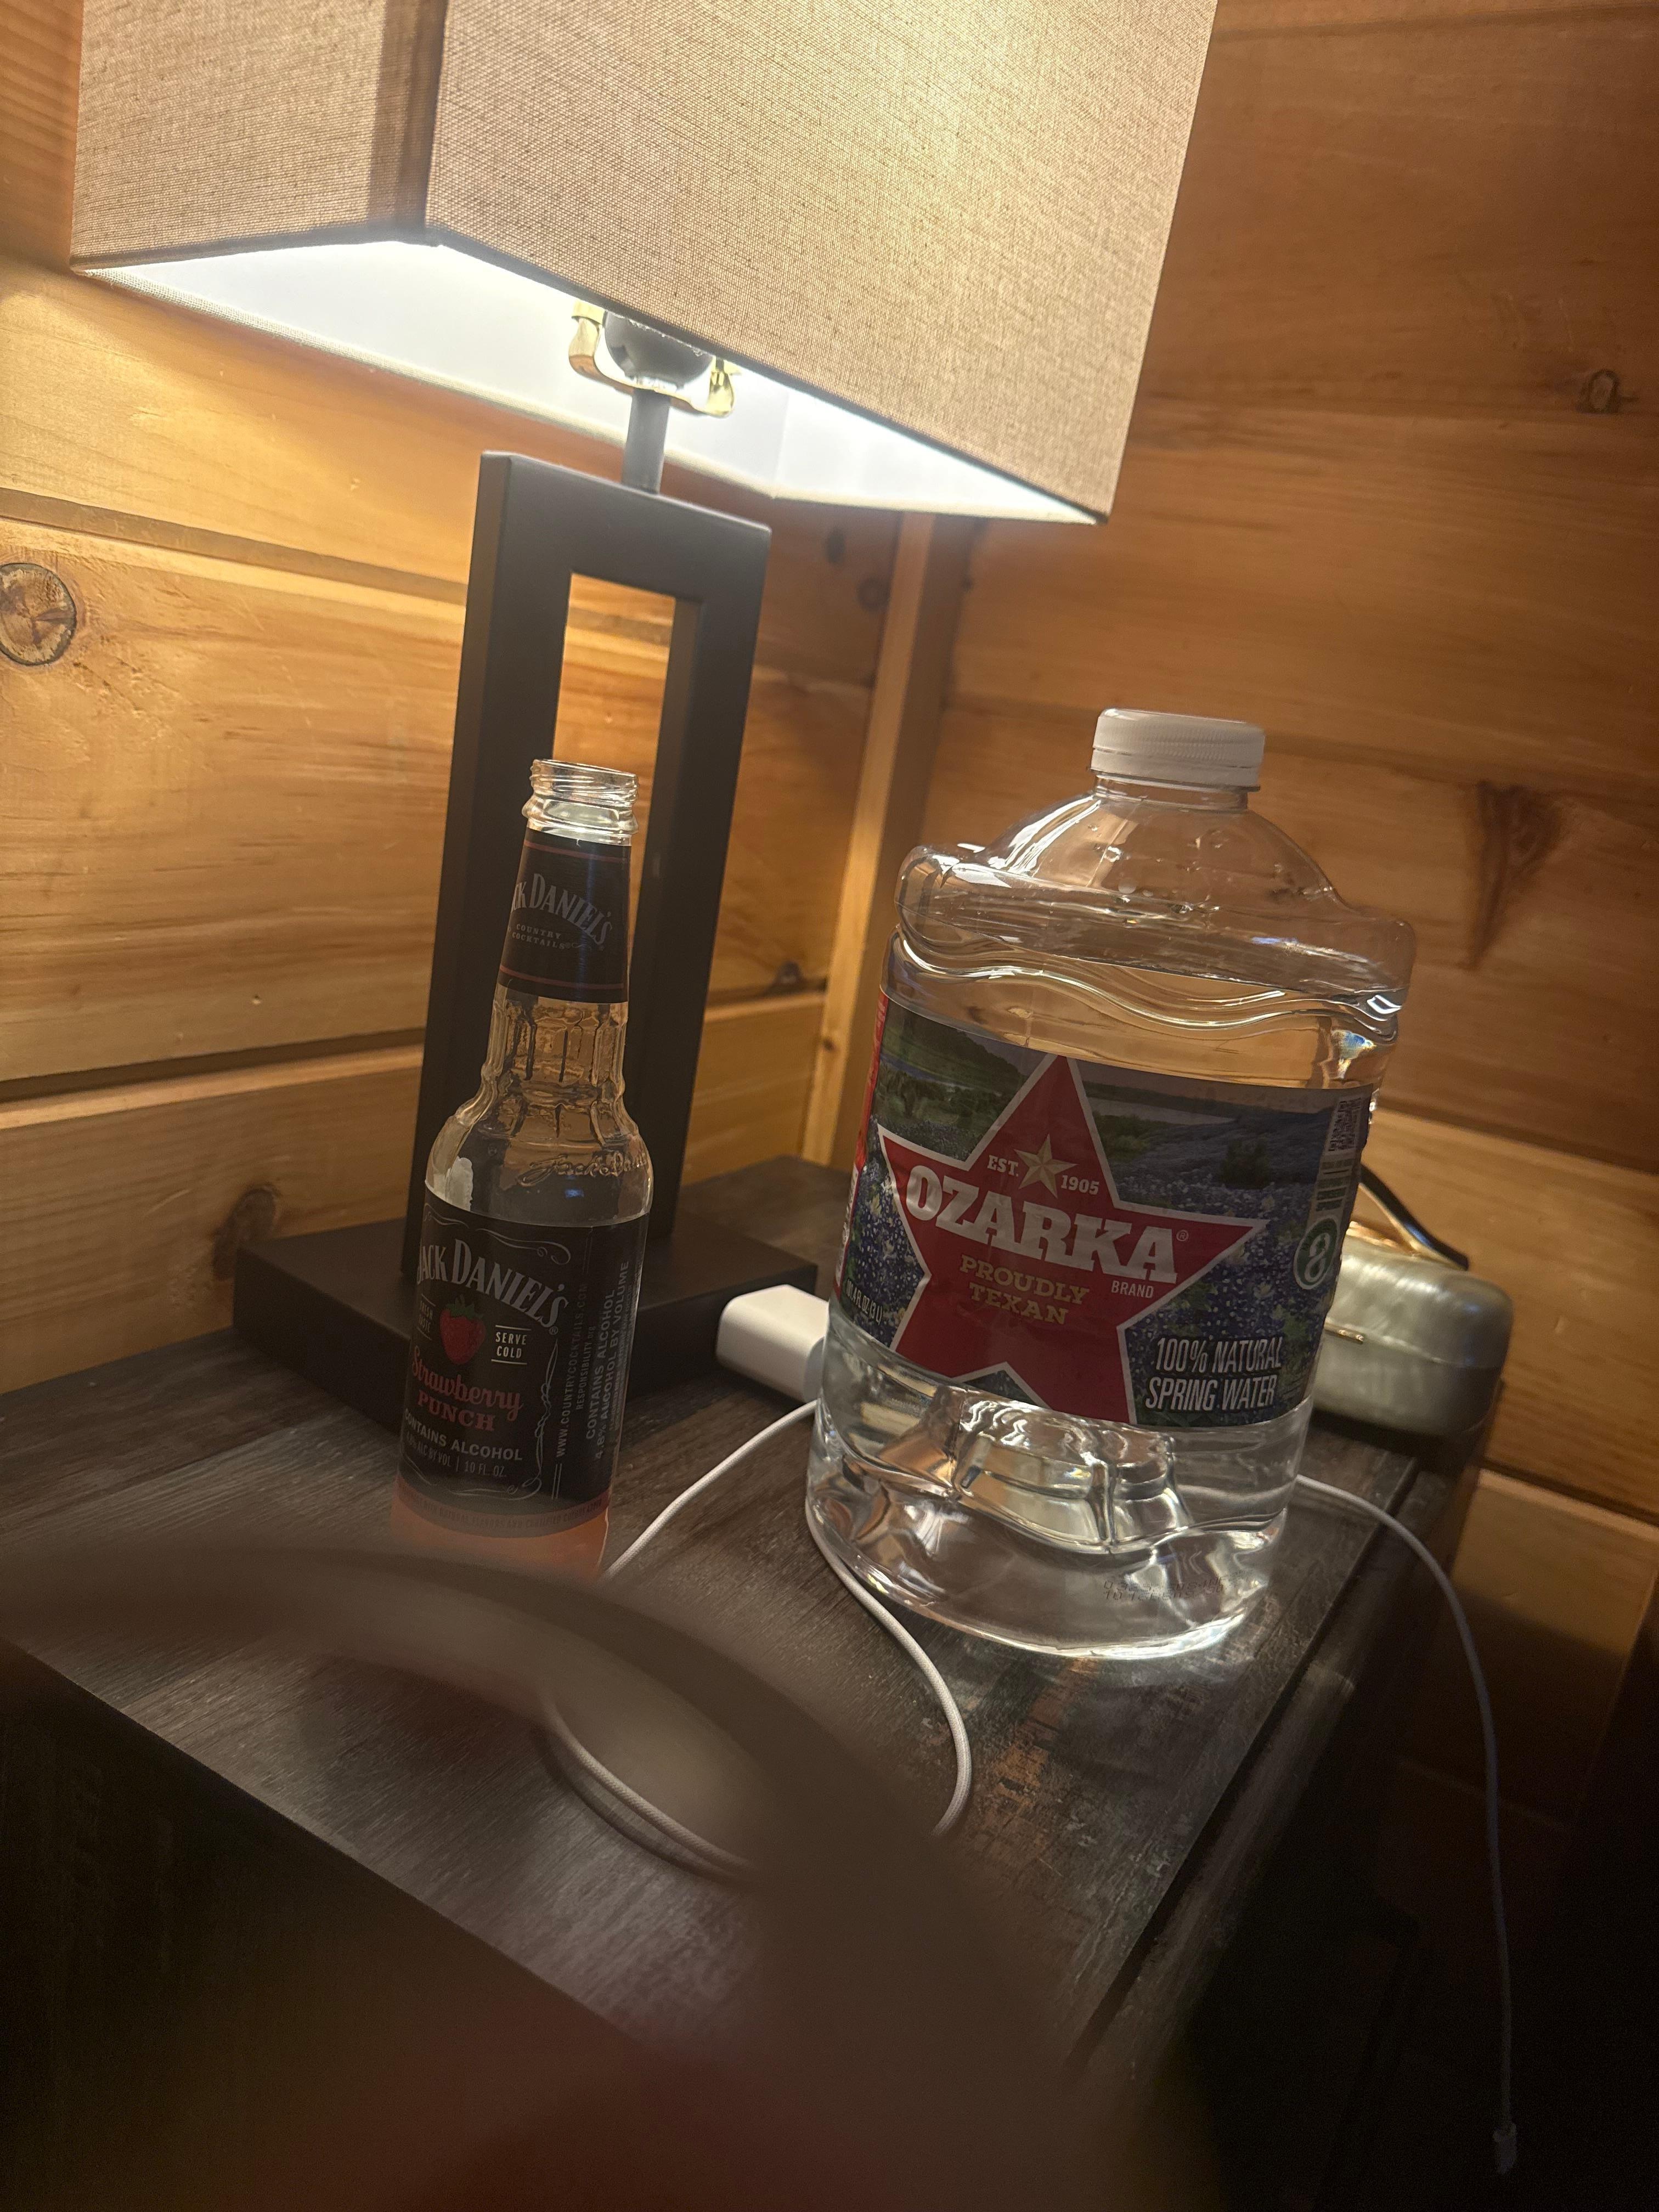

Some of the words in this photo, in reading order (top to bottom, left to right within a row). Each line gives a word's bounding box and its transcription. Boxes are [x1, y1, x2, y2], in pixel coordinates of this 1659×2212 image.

[529, 873, 612, 946] DANIEL'S
[511, 932, 566, 950] COCKTAILS
[516, 923, 561, 940] COUNTRY
[987, 1154, 1019, 1177] EST.
[1060, 1175, 1099, 1197] 1905
[905, 1165, 1177, 1284] OZARKA
[451, 1238, 569, 1329] DANIEL'S
[612, 1260, 630, 1325] VOLUME
[959, 1254, 1090, 1305] PROUDLY
[1111, 1280, 1154, 1299] BRAND
[969, 1282, 1069, 1326] TEXAN
[495, 1331, 527, 1345] SERVE
[496, 1345, 522, 1359] COLD
[609, 1328, 620, 1348] BY
[1156, 1337, 1208, 1373] 100%
[1211, 1337, 1282, 1374] NATURAL
[412, 1345, 524, 1422] Strawberry
[585, 1364, 605, 1440] CONTAINS
[596, 1289, 616, 1359] ALCOHOL
[600, 1351, 618, 1420] ALCOHOL
[416, 1389, 496, 1432] PUNCH
[1146, 1376, 1218, 1412] SPRING
[1221, 1374, 1278, 1411] WATER
[405, 1408, 447, 1447] CONTAINS
[451, 1439, 523, 1461] ALCOHOL
[438, 1452, 452, 1468] VOL
[464, 1460, 476, 1474] 10
